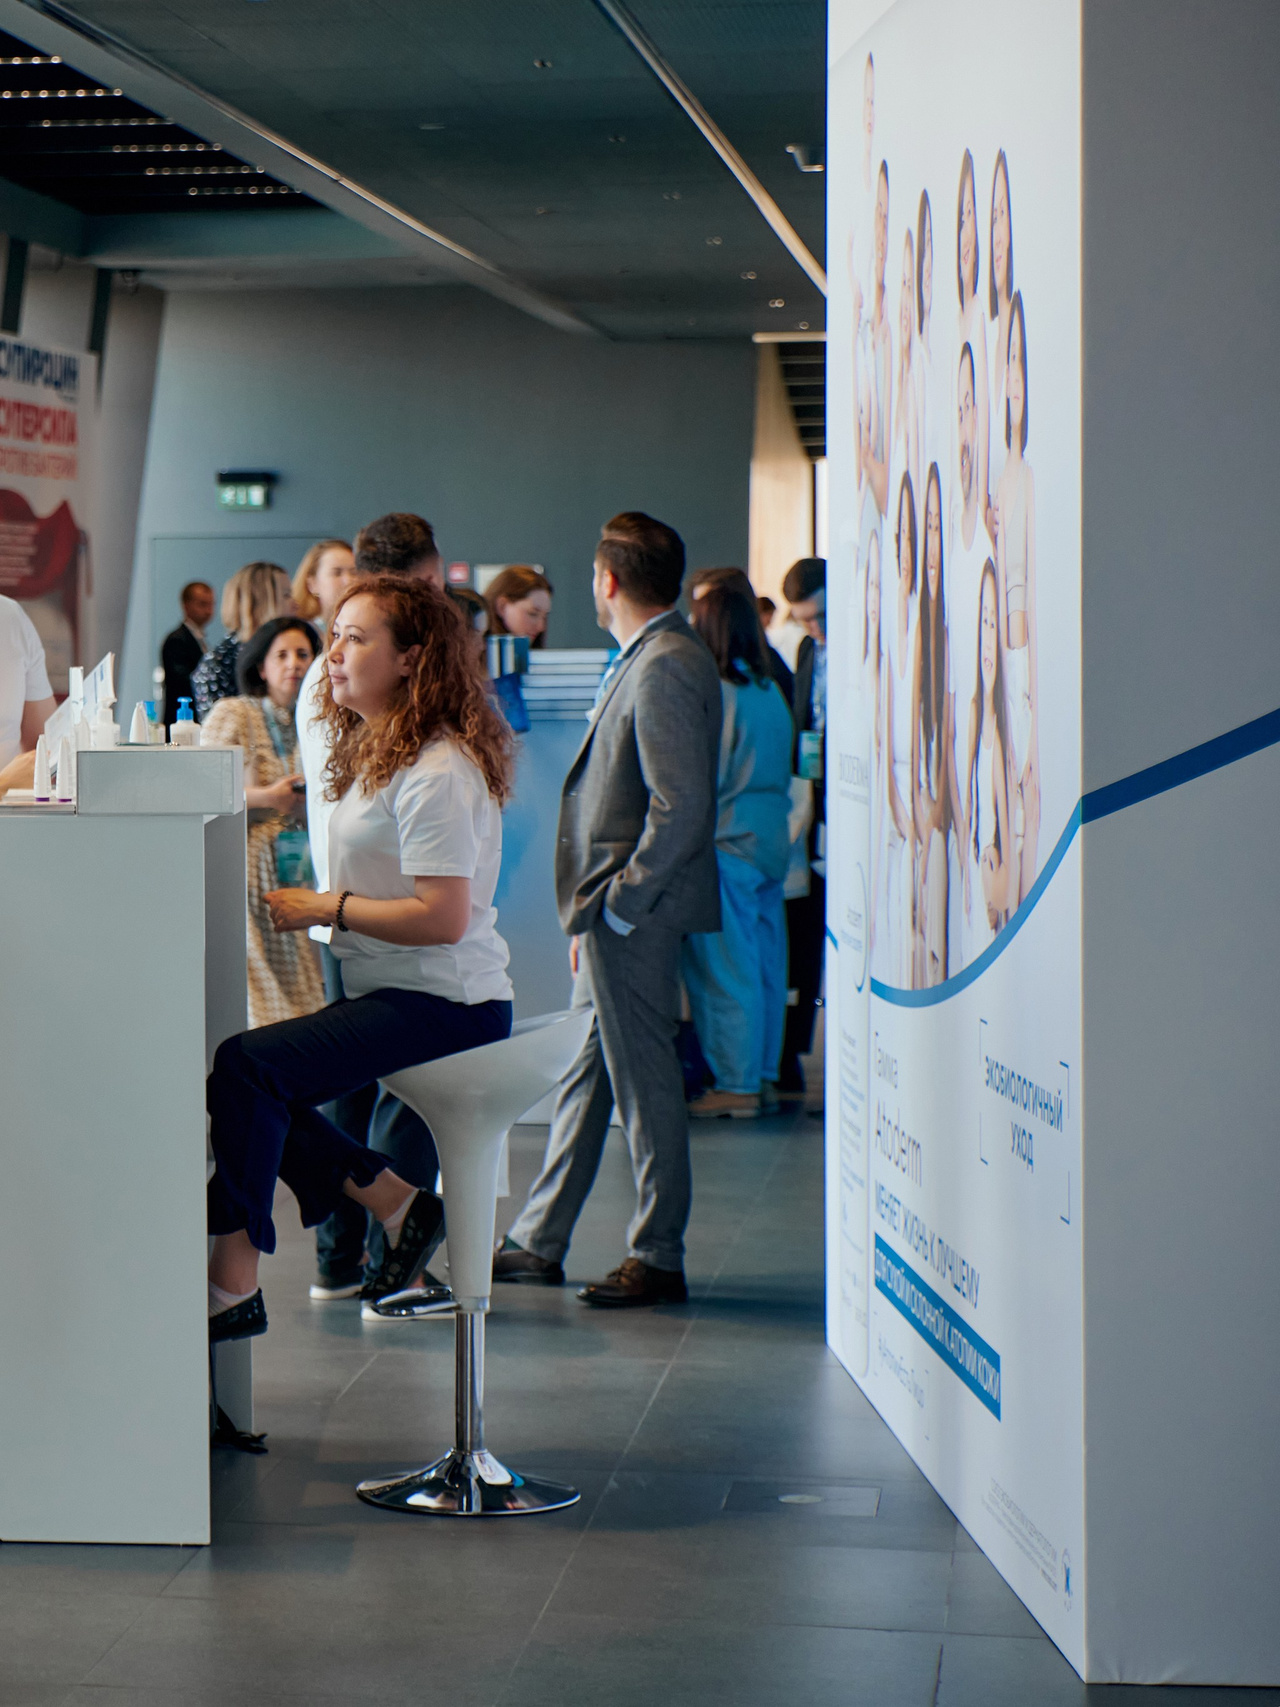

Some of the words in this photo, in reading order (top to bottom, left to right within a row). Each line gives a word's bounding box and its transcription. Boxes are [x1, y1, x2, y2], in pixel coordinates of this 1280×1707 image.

[985, 1055, 1063, 1133] ЭКОБИОЛОГИЧНЫЙ
[874, 1097, 922, 1188] Atoderm
[1011, 1121, 1034, 1174] УХОД
[874, 1179, 901, 1235] МЕНЯЕТ
[901, 1203, 928, 1262] ЖИЗНЬ
[929, 1229, 936, 1271] К
[936, 1236, 980, 1310] ЛУЧШЕМУ
